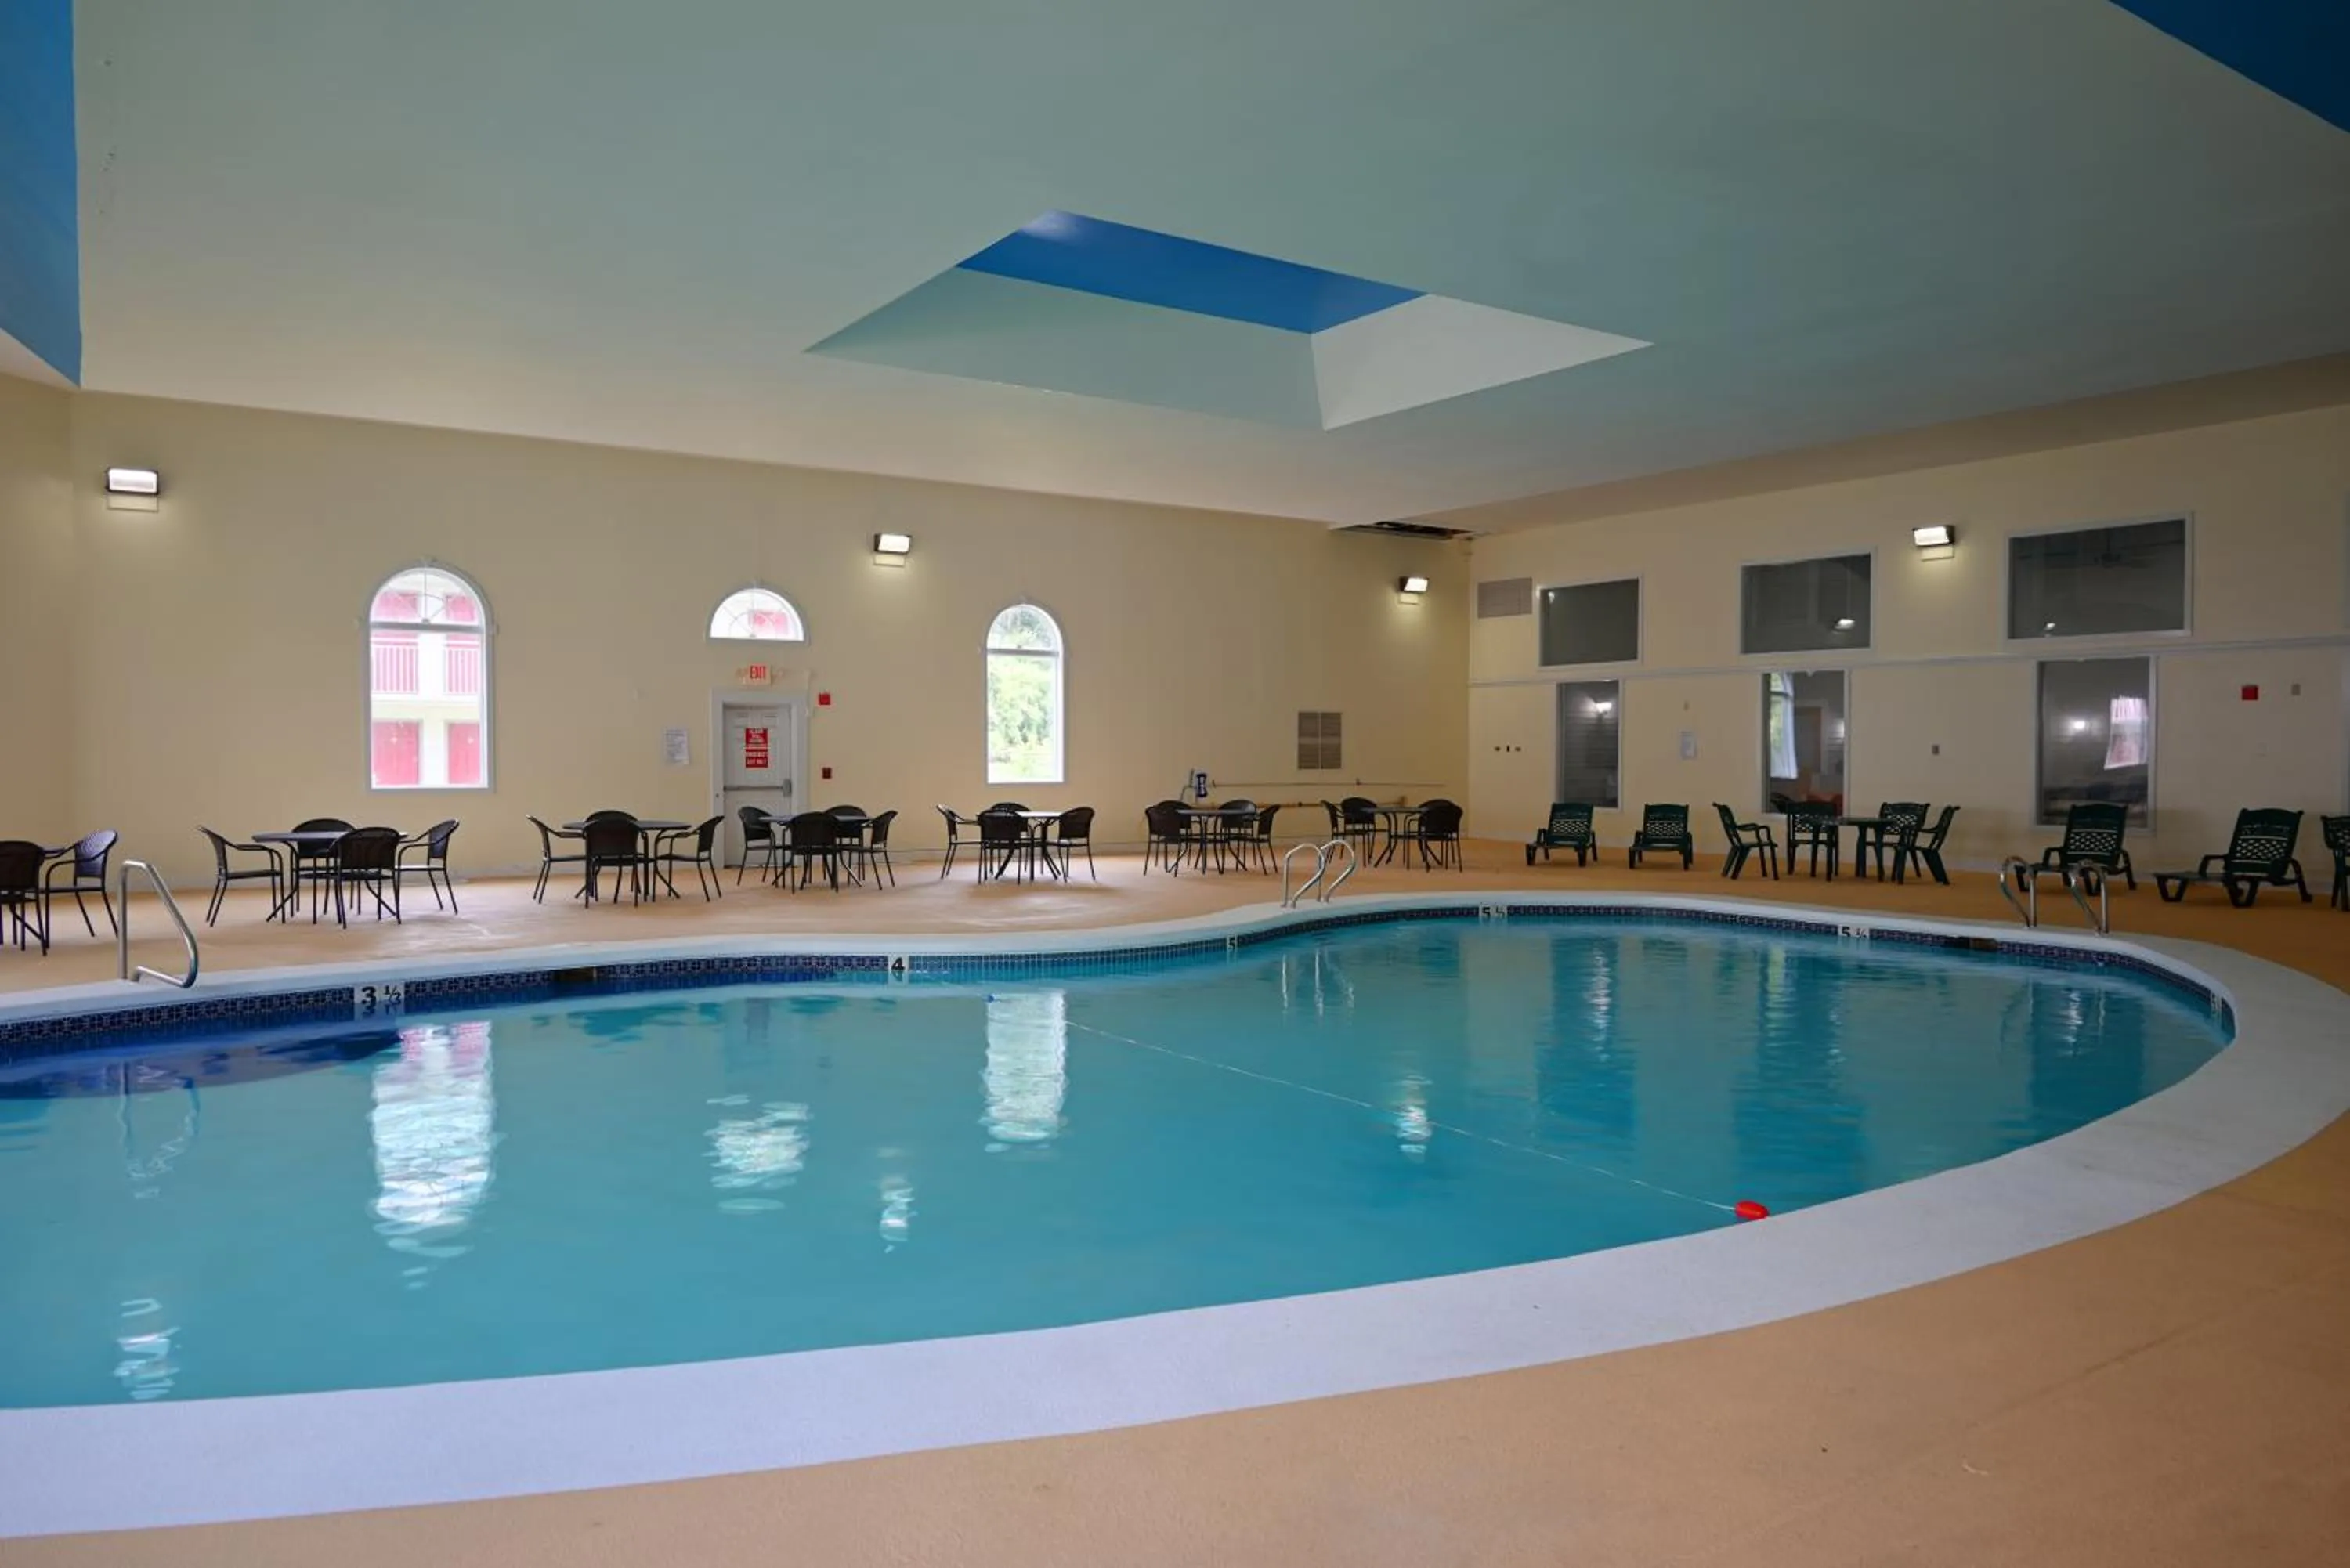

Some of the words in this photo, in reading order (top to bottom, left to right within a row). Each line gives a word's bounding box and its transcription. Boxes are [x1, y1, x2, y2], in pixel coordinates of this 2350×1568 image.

[750, 665, 766, 679] EXIT
[891, 956, 906, 971] 4
[362, 986, 376, 1005] 3
